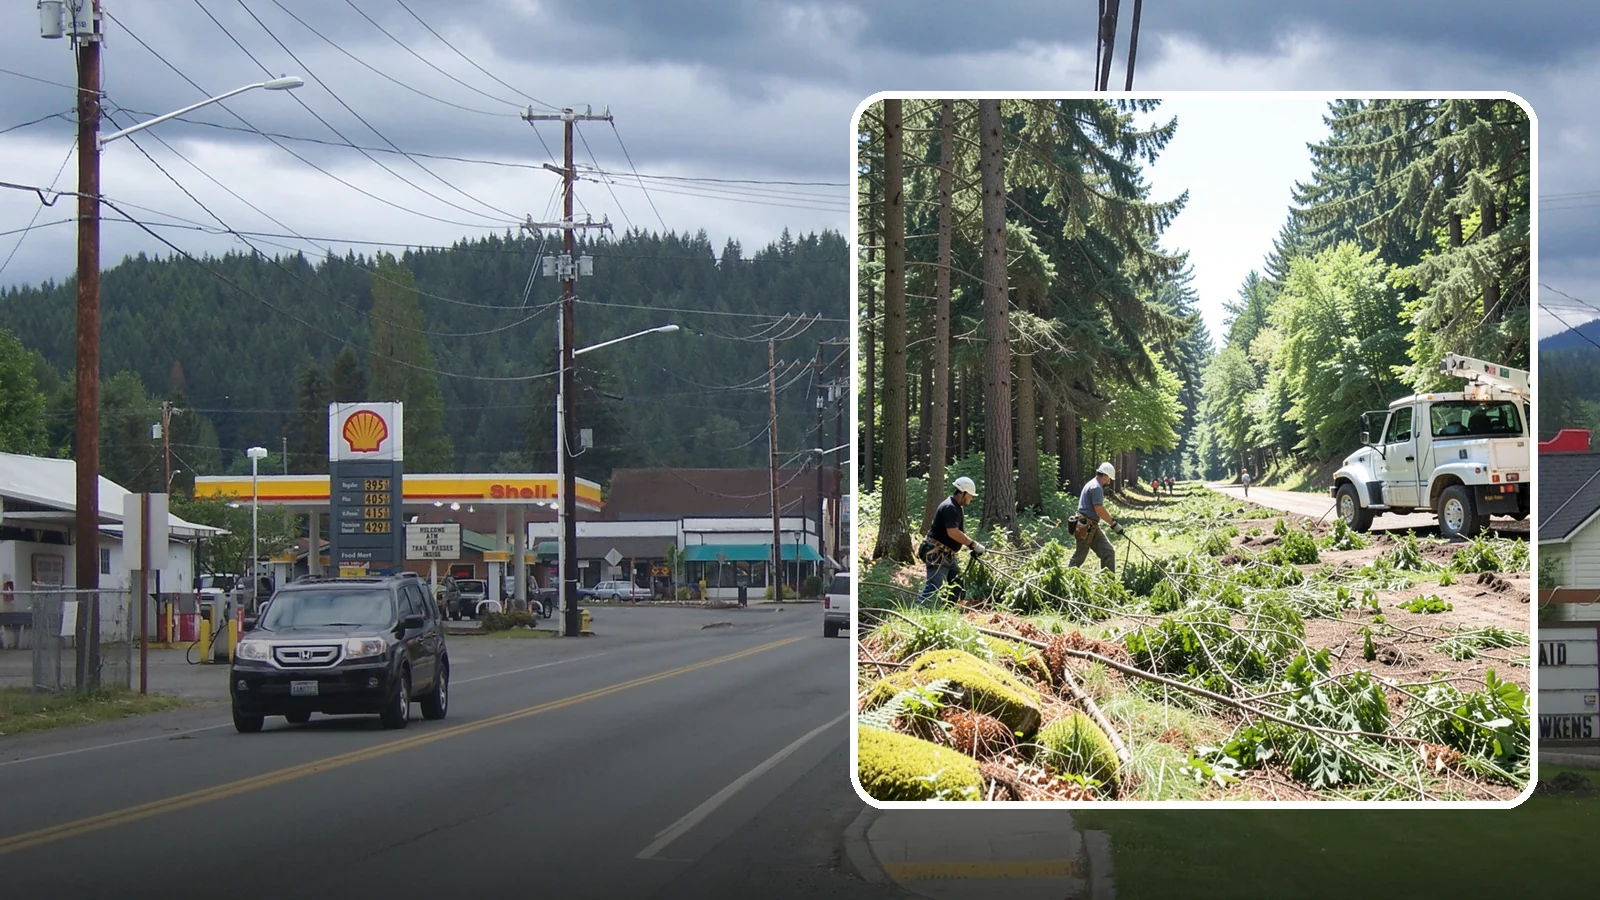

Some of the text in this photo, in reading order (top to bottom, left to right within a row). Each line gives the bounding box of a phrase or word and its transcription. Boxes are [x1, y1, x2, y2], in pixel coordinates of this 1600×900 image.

[365, 480, 383, 490] 395
[489, 484, 547, 499] Shell
[365, 494, 383, 504] 405
[365, 508, 383, 518] 415
[365, 522, 383, 532] 429
[1538, 643, 1566, 665] AID
